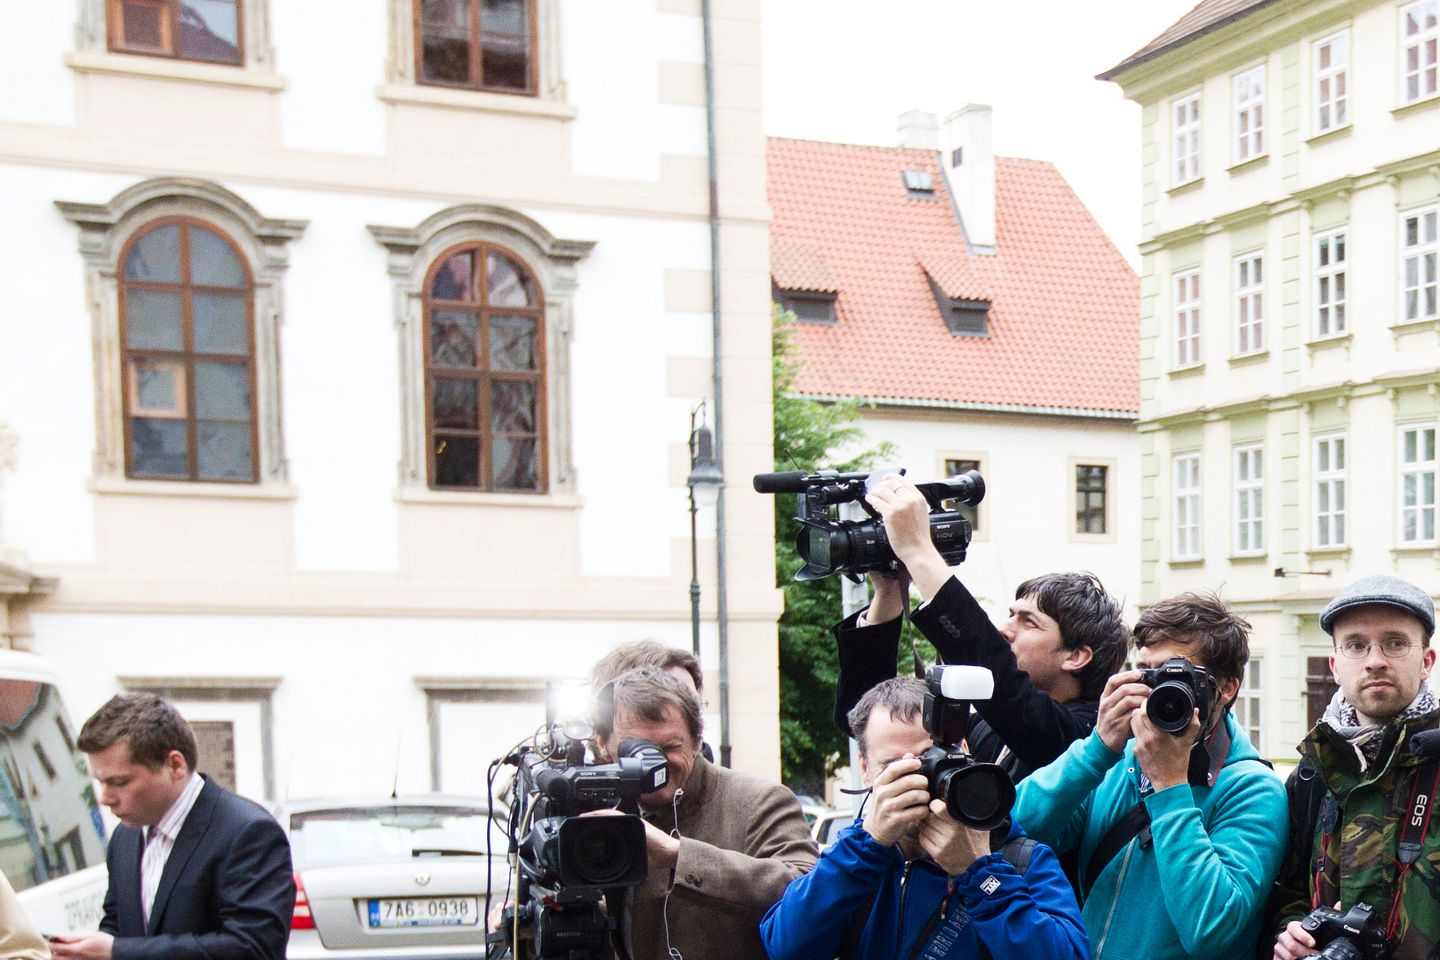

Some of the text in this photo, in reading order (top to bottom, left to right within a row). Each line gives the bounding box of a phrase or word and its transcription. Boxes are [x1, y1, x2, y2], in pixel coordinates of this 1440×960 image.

[1411, 794, 1428, 827] EOS
[383, 899, 469, 918] 7A6 0938
[1343, 924, 1361, 935] Canon
